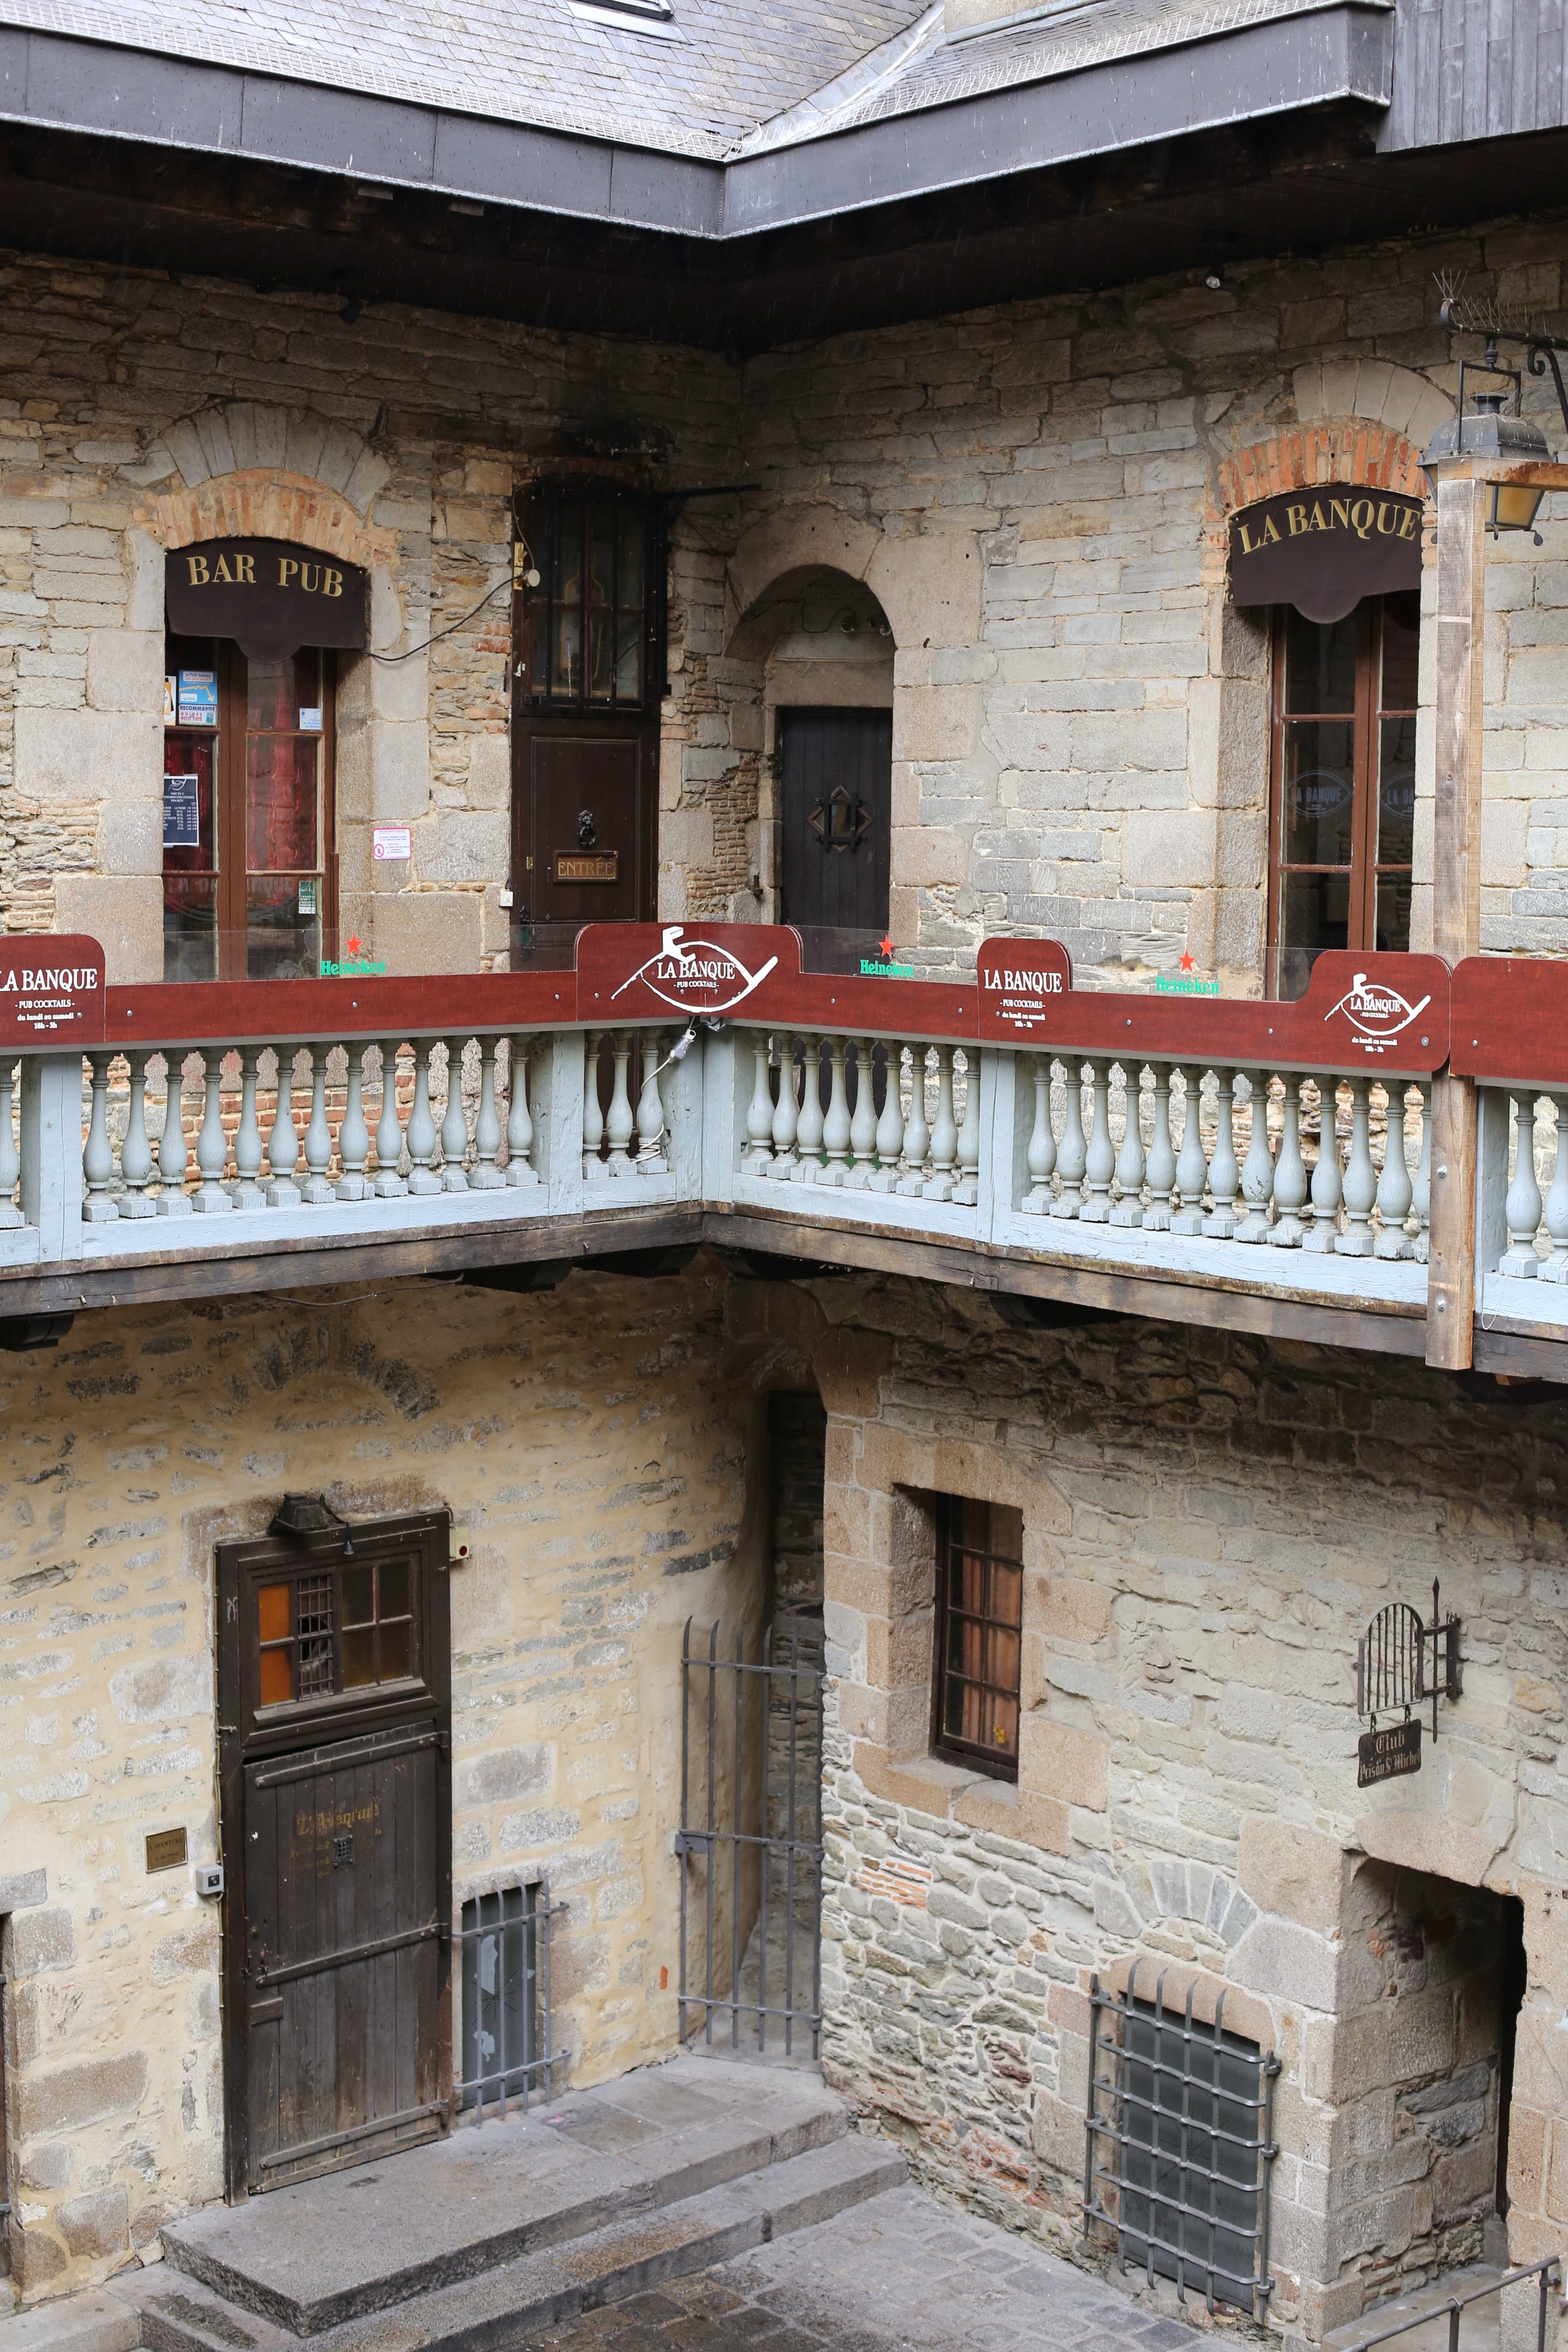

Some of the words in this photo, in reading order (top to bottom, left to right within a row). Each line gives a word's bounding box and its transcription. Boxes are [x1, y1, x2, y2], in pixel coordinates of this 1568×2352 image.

[1238, 514, 1282, 554] LA
[1286, 499, 1421, 541] BANQUE
[186, 554, 256, 586] BAR
[278, 558, 343, 597] PUB
[1307, 787, 1341, 805] BANQUE
[1388, 789, 1398, 805] LA
[558, 856, 613, 876] ENTRÉE
[321, 960, 385, 975] Heineken
[657, 961, 677, 979] LA
[679, 961, 735, 980] BANQUE
[860, 960, 913, 977] Heineken
[0, 969, 19, 991] LA
[21, 968, 97, 993] BANQUE
[984, 969, 1002, 990] LA
[1004, 970, 1062, 994] BANQUE
[1156, 976, 1219, 994] Heineken
[19, 1000, 33, 1009] PUB
[33, 999, 71, 1008] COCKTAILS
[1003, 999, 1013, 1007] PUB
[1014, 1000, 1042, 1009] COCKTAILS
[1350, 997, 1362, 1010] LA
[1363, 998, 1401, 1013] BANQUE
[1376, 1731, 1405, 1753] Club
[1360, 1764, 1384, 1781] Prison
[1393, 1748, 1420, 1770] Michel
